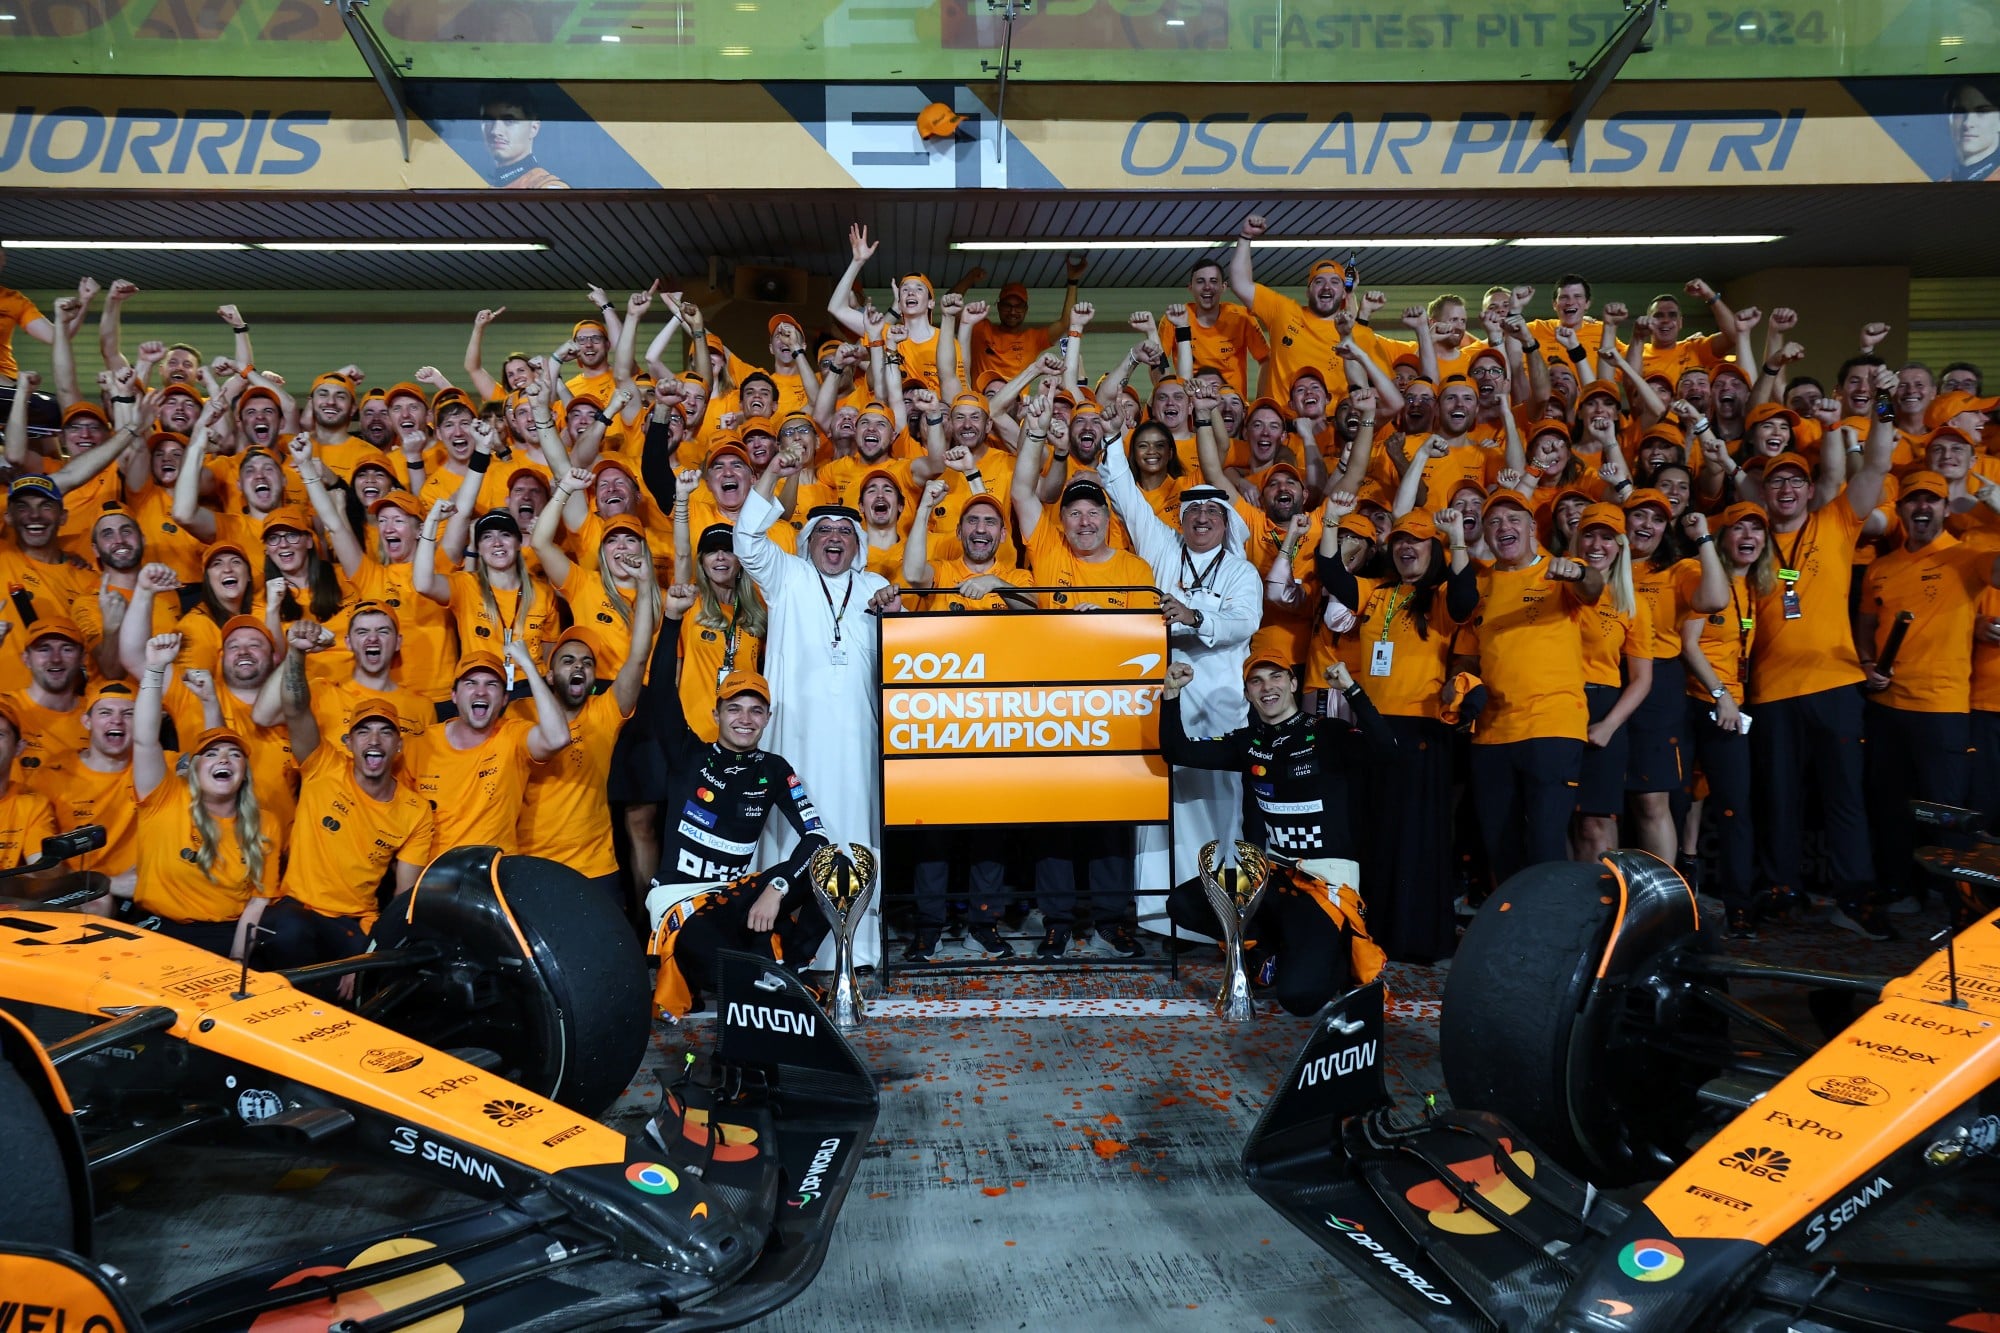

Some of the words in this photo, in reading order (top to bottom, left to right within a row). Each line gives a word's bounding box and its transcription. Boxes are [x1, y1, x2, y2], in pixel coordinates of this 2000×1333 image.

[1252, 13, 1464, 49] FASTEST
[1475, 13, 1556, 48] PIT
[1568, 12, 1693, 47] STP
[1705, 10, 1828, 46] 2024
[1121, 112, 1430, 176] OSCAR
[1442, 108, 1806, 175] PIASTRI
[892, 652, 985, 681] 2024
[888, 689, 1161, 720] CONSTRUCTORS'
[889, 720, 1110, 750] CHAMPIONS
[1247, 746, 1274, 761] Android
[700, 767, 727, 790] Android
[173, 971, 241, 994] Hilton
[1938, 974, 2000, 993] Hilto
[242, 999, 313, 1025] alteryx
[727, 1002, 815, 1037] ARROW
[1883, 1009, 1983, 1039] alteryx
[292, 1019, 357, 1043] webex
[1298, 1039, 1376, 1090] ARROW
[1854, 1039, 1941, 1065] webex
[418, 1074, 479, 1100] FxPro
[497, 1105, 544, 1128] CNBC
[1762, 1110, 1844, 1142] FxPro
[421, 1140, 505, 1189] SENNA
[806, 1138, 841, 1177] WORLD
[1718, 1156, 1788, 1183] CNBC
[1685, 1185, 1753, 1212] PIRELLI
[1829, 1176, 1894, 1229] SENNA
[1373, 1252, 1453, 1305] WORLD
